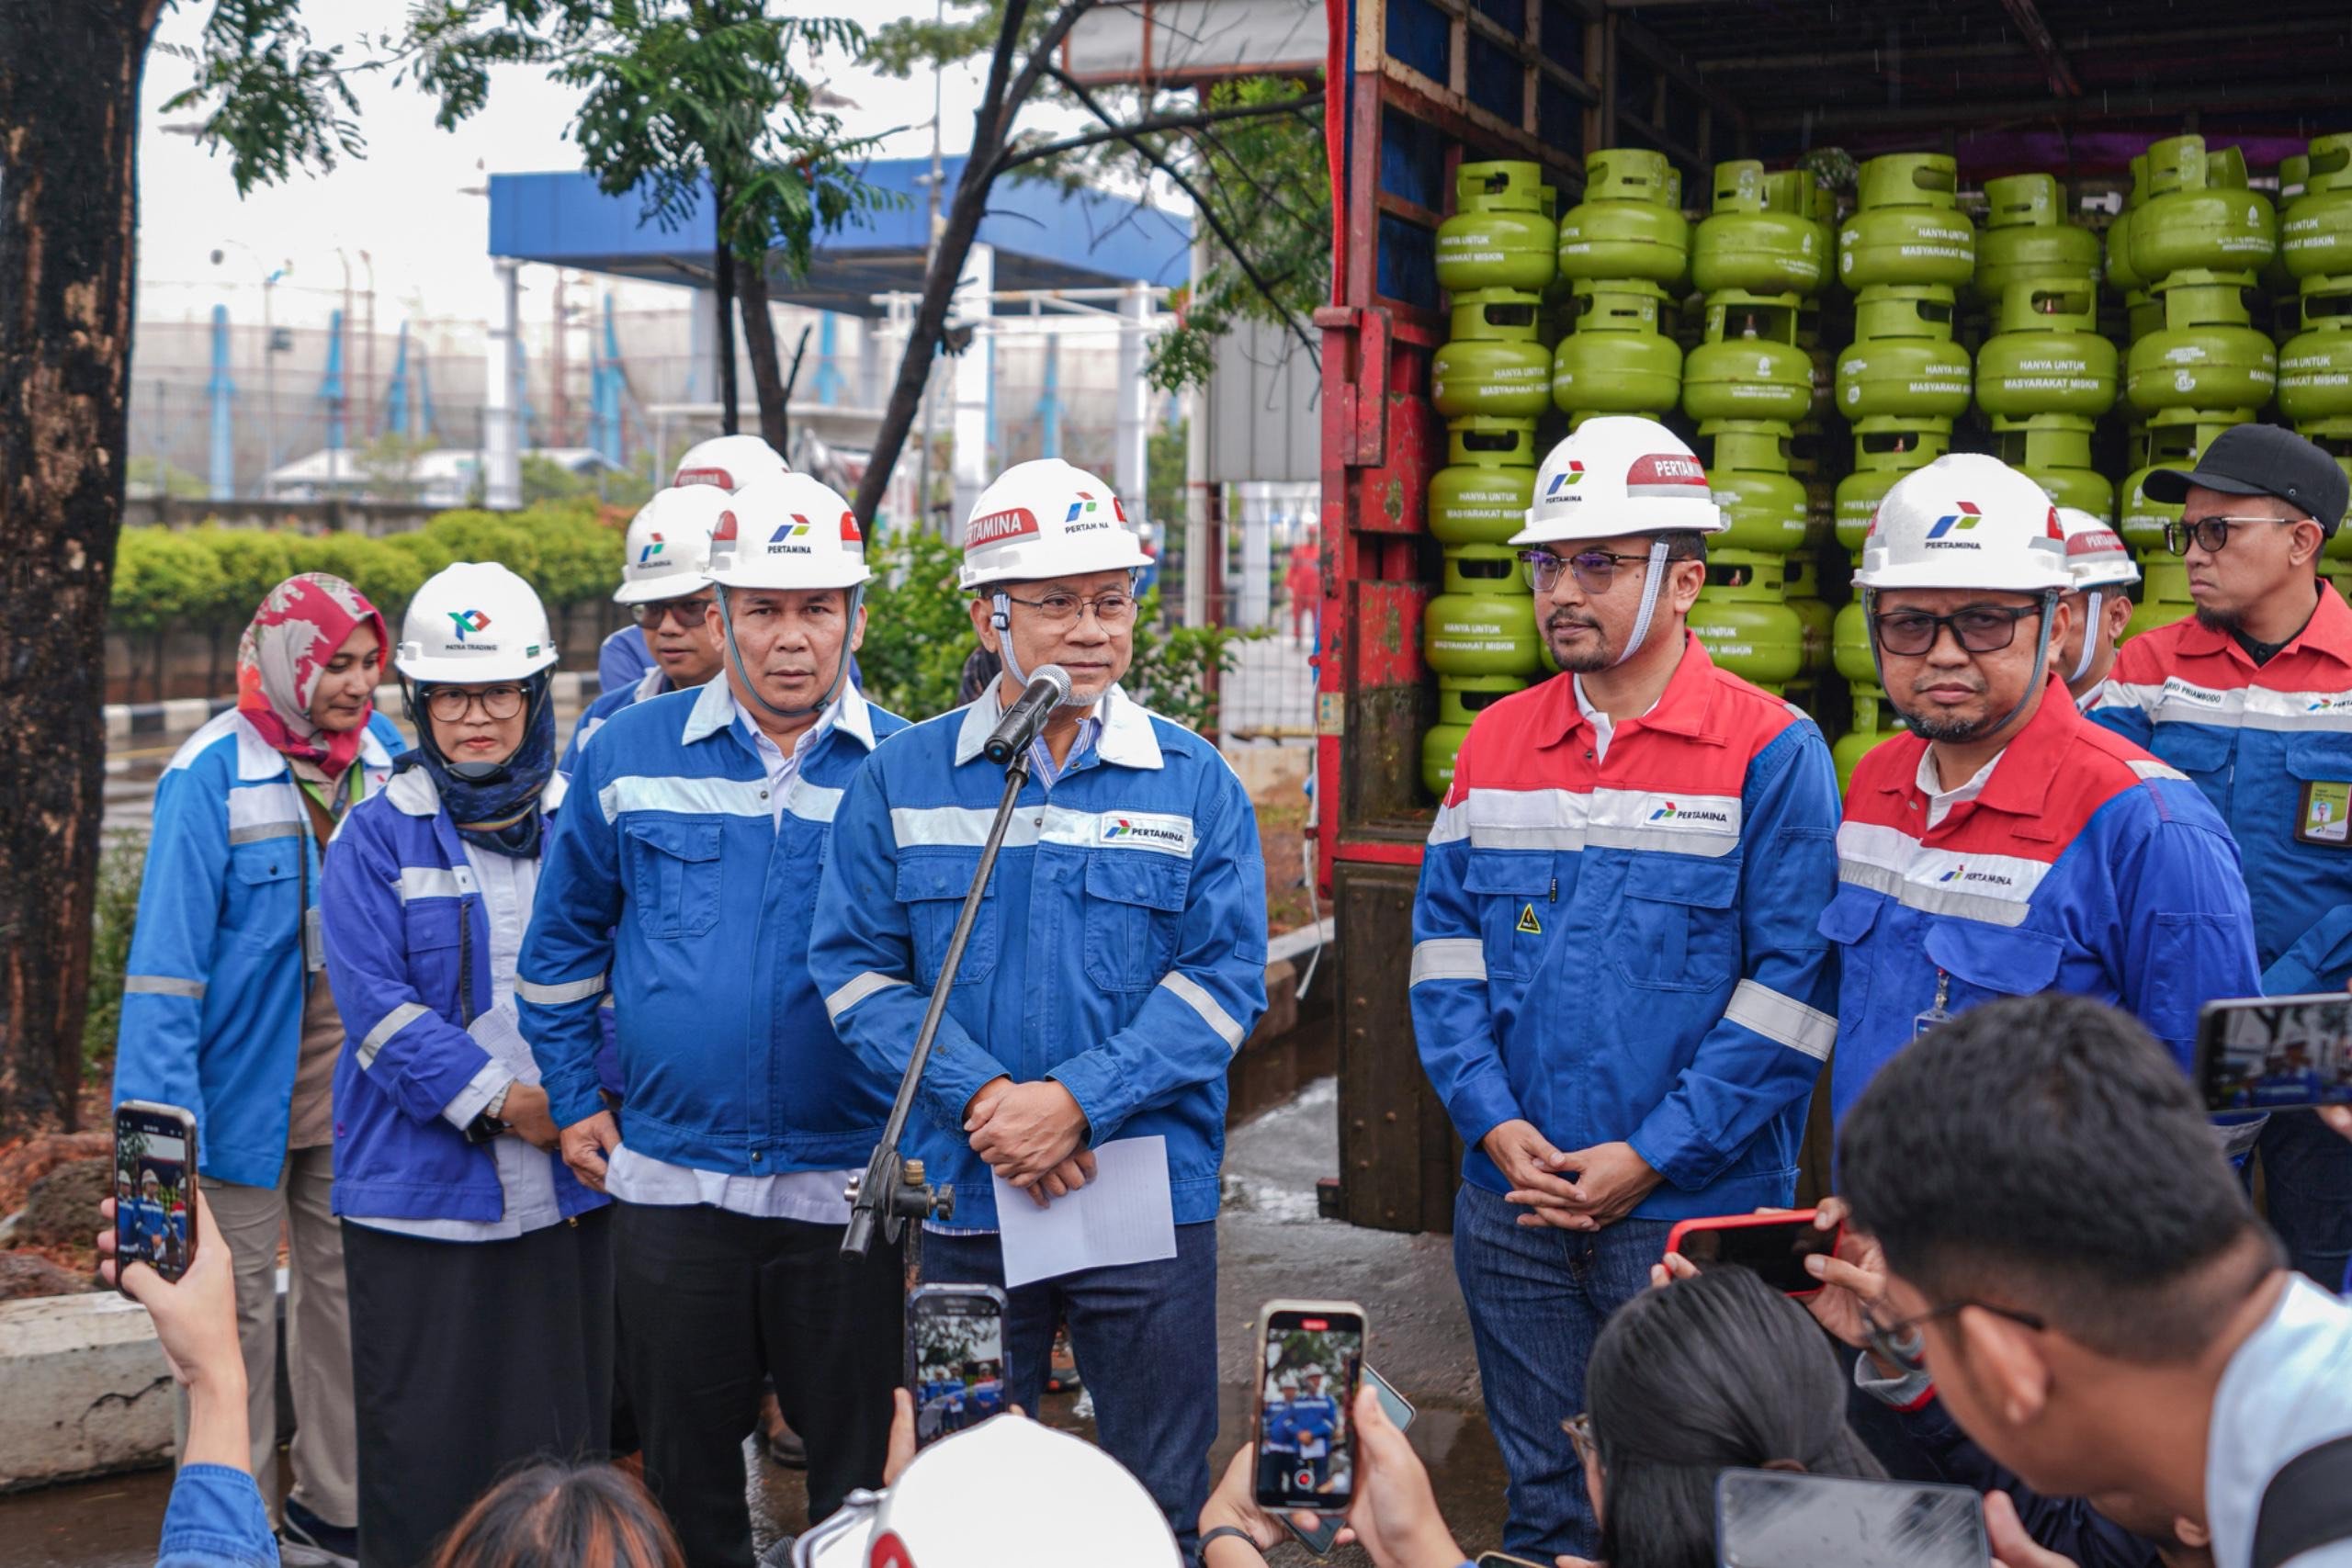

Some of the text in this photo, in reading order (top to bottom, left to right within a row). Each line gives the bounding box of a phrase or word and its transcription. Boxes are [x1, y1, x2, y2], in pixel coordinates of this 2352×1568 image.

[2020, 360, 2086, 371] HANYA UNTUK
[2004, 378, 2098, 390] MASYARAKAT MISKIN
[1459, 492, 1518, 502] HANYA UNTUK
[768, 546, 811, 554] PERTAMINA
[1925, 542, 1981, 550] PERTAMINA
[1444, 623, 1501, 634] HANYA UNTUK
[2181, 686, 2221, 703] PRIAMBODO
[1677, 811, 1727, 822] PERTAMINA
[1132, 828, 1183, 842] PERTAMINA
